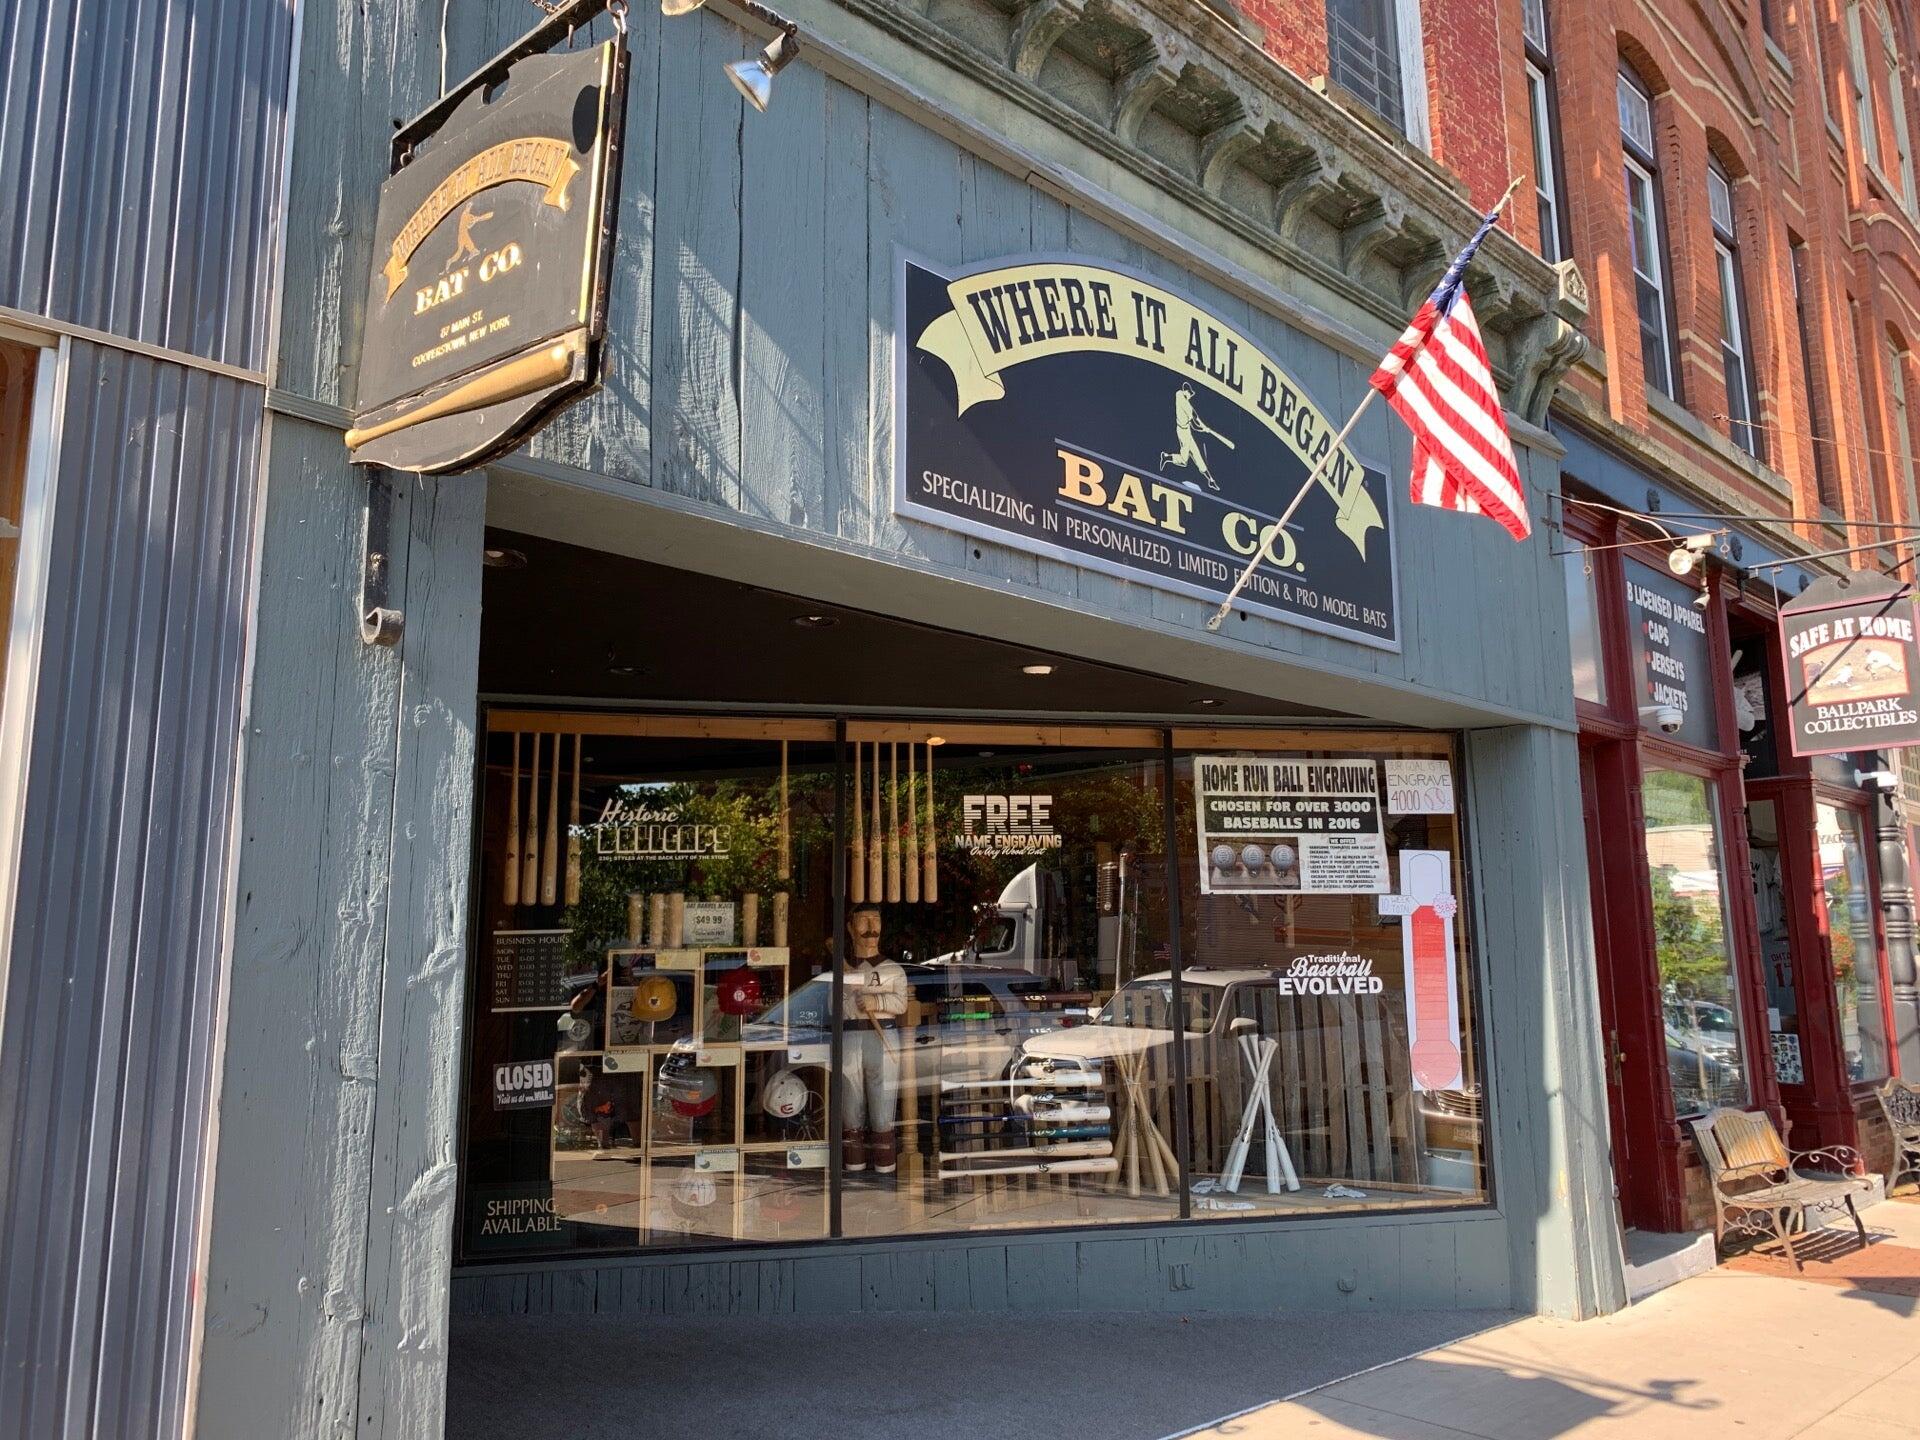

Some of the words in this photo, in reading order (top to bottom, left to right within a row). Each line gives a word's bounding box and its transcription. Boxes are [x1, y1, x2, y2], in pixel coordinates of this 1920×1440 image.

[397, 183, 449, 260] WHERE
[454, 165, 472, 198] IT
[477, 147, 505, 187] ALL
[509, 142, 565, 181] BEGAN
[413, 268, 470, 316] BAT
[479, 241, 522, 282] CO.
[451, 315, 471, 333] MAIN
[469, 325, 487, 343] NEW
[489, 314, 511, 333] YORK
[966, 278, 1118, 355] WHERE
[1131, 291, 1168, 353] IT
[1184, 317, 1245, 394] ALL
[1257, 363, 1357, 498] BEGAN
[1057, 450, 1193, 535] BAT
[1222, 511, 1306, 573] CO.
[922, 470, 1035, 526] SPECIALIZING
[1042, 511, 1059, 532] IN
[1066, 517, 1173, 568] PERSONALIZED,
[1178, 554, 1229, 582] LIMITED
[1283, 583, 1293, 602] &
[1296, 587, 1319, 609] PRO
[1322, 595, 1361, 621] MODEL
[1363, 609, 1388, 630] BATS
[1634, 584, 1672, 619] LICENSED
[1673, 603, 1705, 634] APPAREL
[1648, 620, 1669, 647] CAPS
[1789, 625, 1830, 658] SAFE
[1833, 617, 1855, 640] AT
[1859, 616, 1913, 642] HOME
[1651, 651, 1685, 682] JERSEYS
[1654, 682, 1688, 712] JACKETS
[1817, 697, 1903, 720] BALLPARK
[1804, 710, 1918, 735] COLLECTIBLES
[1202, 764, 1238, 792] HOME
[1243, 764, 1270, 792] RUN
[1273, 764, 1304, 793] BALL
[1307, 764, 1376, 793] ENGRAVING
[1388, 773, 1451, 787] ENGRAVE
[600, 797, 680, 823] Historic
[1210, 800, 1261, 813] CHOSEN
[1266, 800, 1291, 813] FOR
[1295, 801, 1330, 813] OVER
[1333, 801, 1371, 813] 3000
[1391, 789, 1421, 811] 4000
[963, 795, 1054, 835] FREE
[1223, 817, 1303, 830] BASEBALLS
[1307, 817, 1323, 829] IN
[1328, 817, 1361, 830] 2016
[955, 834, 992, 849] NAME
[995, 834, 1063, 849] ENGRAVING
[970, 847, 983, 856] On
[984, 846, 1001, 860] Any
[1002, 846, 1027, 856] Wood
[496, 937, 537, 945] BUSINESS
[539, 936, 571, 944] HOURS
[1287, 952, 1373, 977] Baseball
[1308, 954, 1361, 963] Traditional
[868, 971, 884, 987] A
[1279, 977, 1383, 996] EVOLVED
[496, 1063, 553, 1091] CLOSED
[497, 1094, 510, 1104] Visit
[487, 1199, 556, 1216] SHIPPING
[481, 1216, 562, 1235] AVAILABLE
